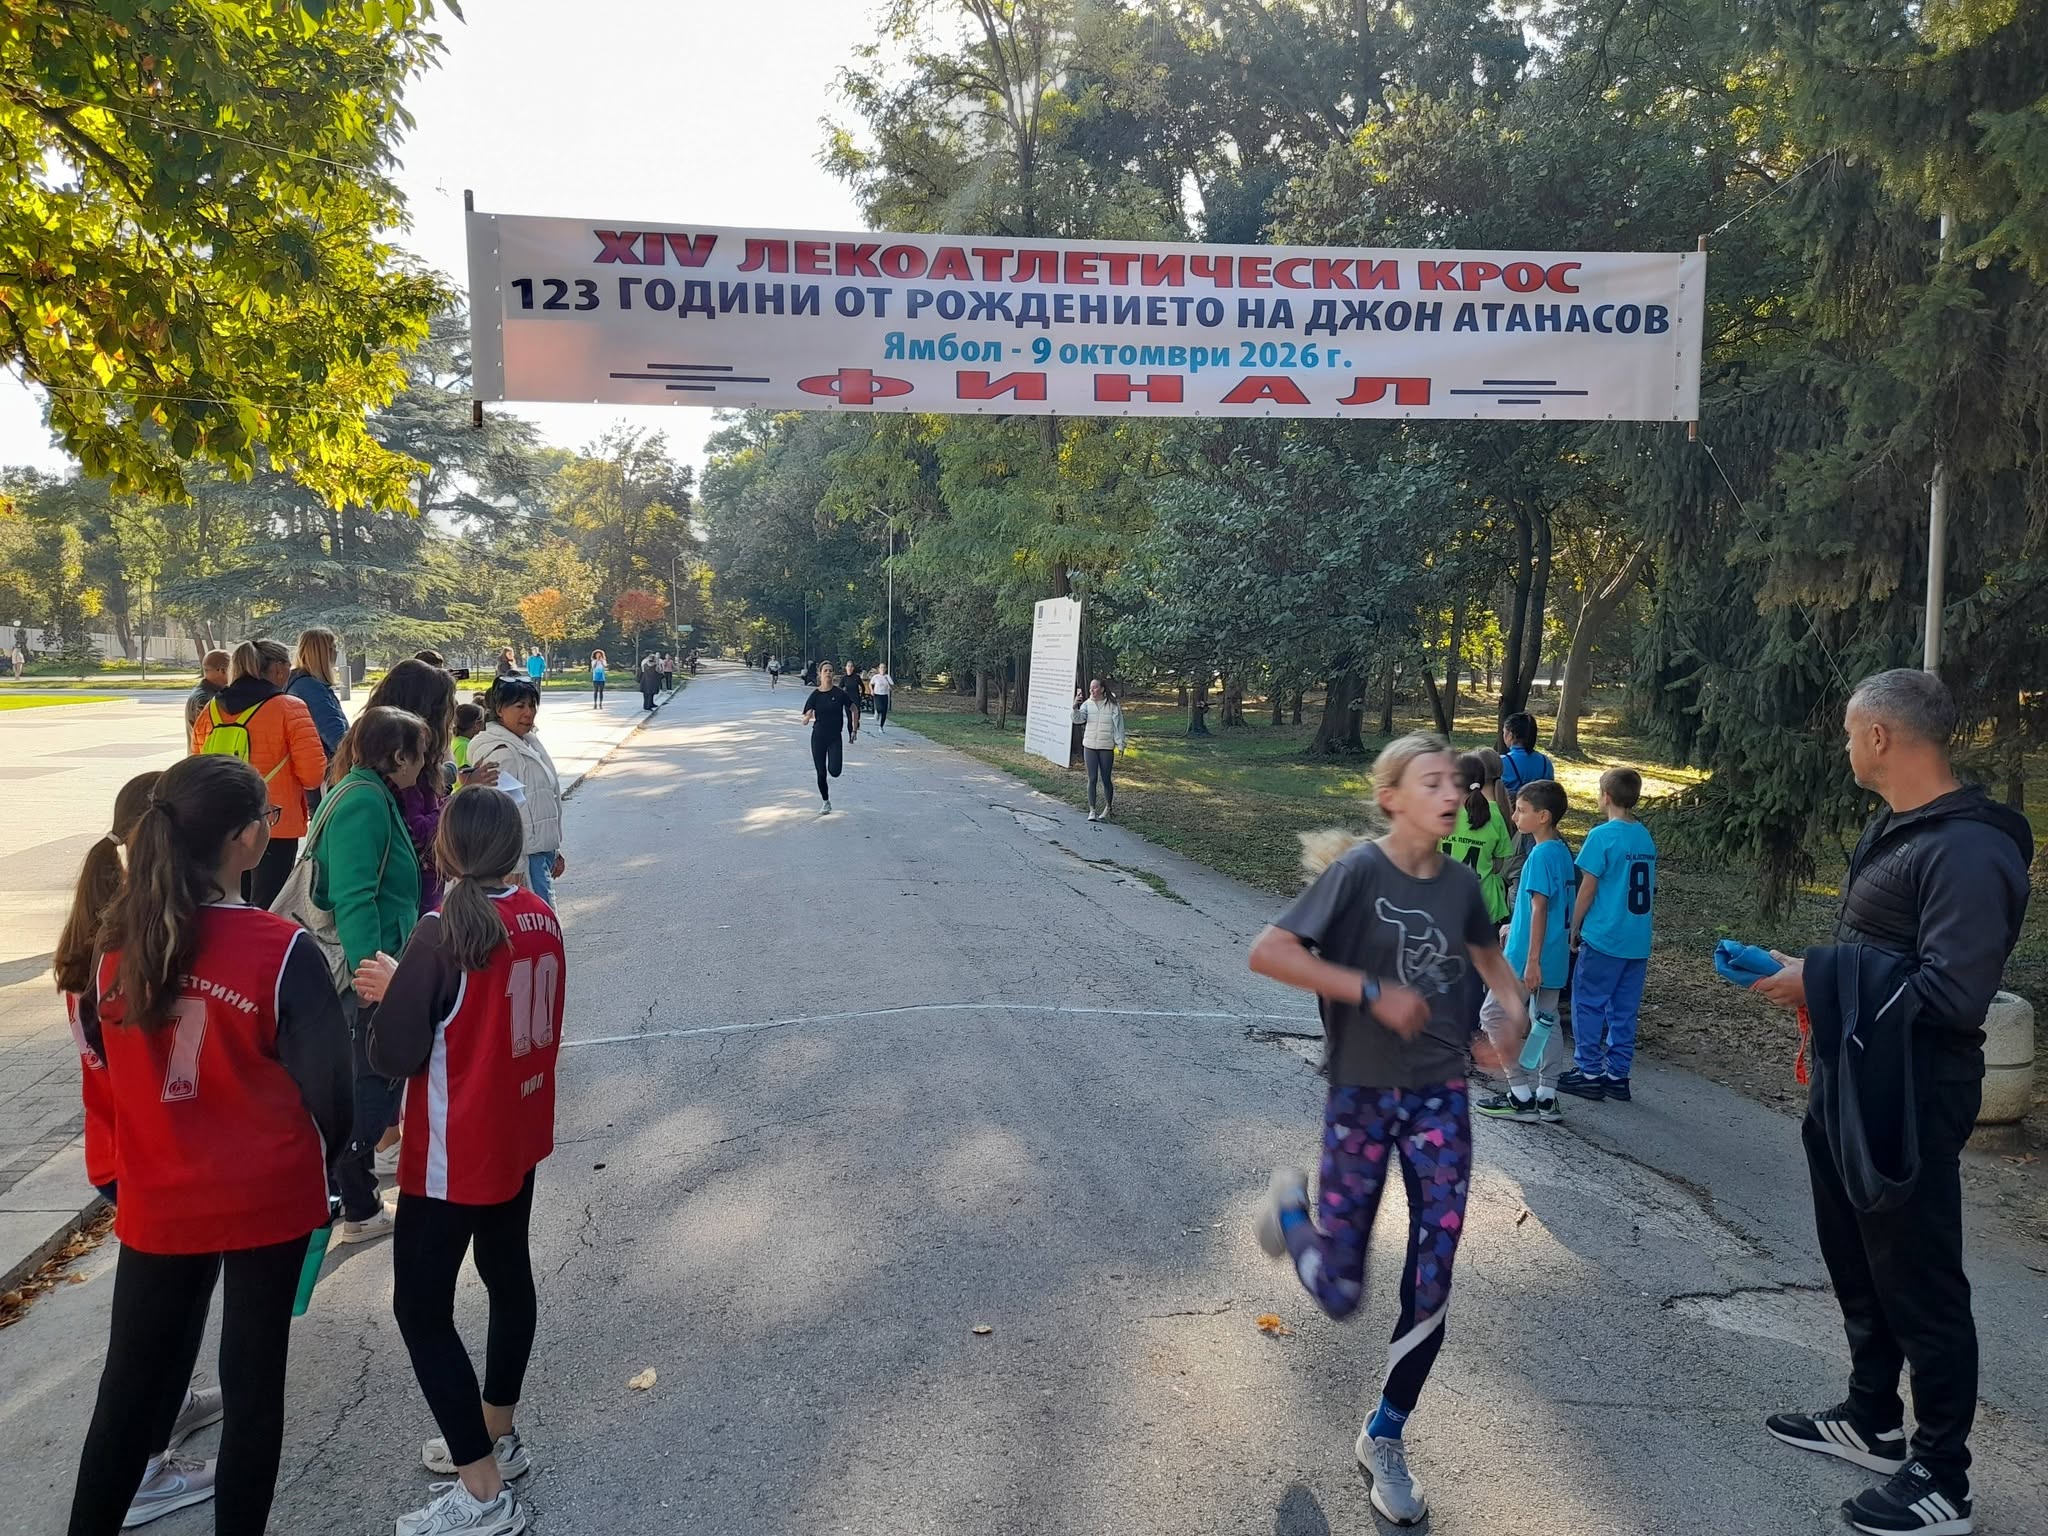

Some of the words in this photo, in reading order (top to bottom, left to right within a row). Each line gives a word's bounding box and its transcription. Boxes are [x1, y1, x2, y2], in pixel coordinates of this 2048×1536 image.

[593, 230, 718, 267] XIV
[736, 239, 1399, 291] ЛЕКОАТЛЕТИЧЕСКИ
[1418, 260, 1582, 294] КРОС
[511, 278, 600, 311] 123
[619, 277, 820, 319] ГОДИНИ
[834, 286, 893, 318] ОТ
[906, 288, 1224, 330] РОЖДЕНИЕТО
[1237, 298, 1295, 329] НА
[1304, 298, 1440, 336] ДЖОН
[1453, 303, 1669, 334] АТАНАСОВ
[884, 331, 1002, 362] Ямбол
[1031, 337, 1051, 364] 9
[1058, 341, 1231, 373] октомври
[1239, 341, 1319, 368] 2026
[1327, 348, 1353, 368] г.
[796, 368, 1432, 405] ФИНАЛ
[1628, 862, 1651, 915] 8
[505, 952, 559, 1058] 10
[161, 995, 209, 1102] 7
